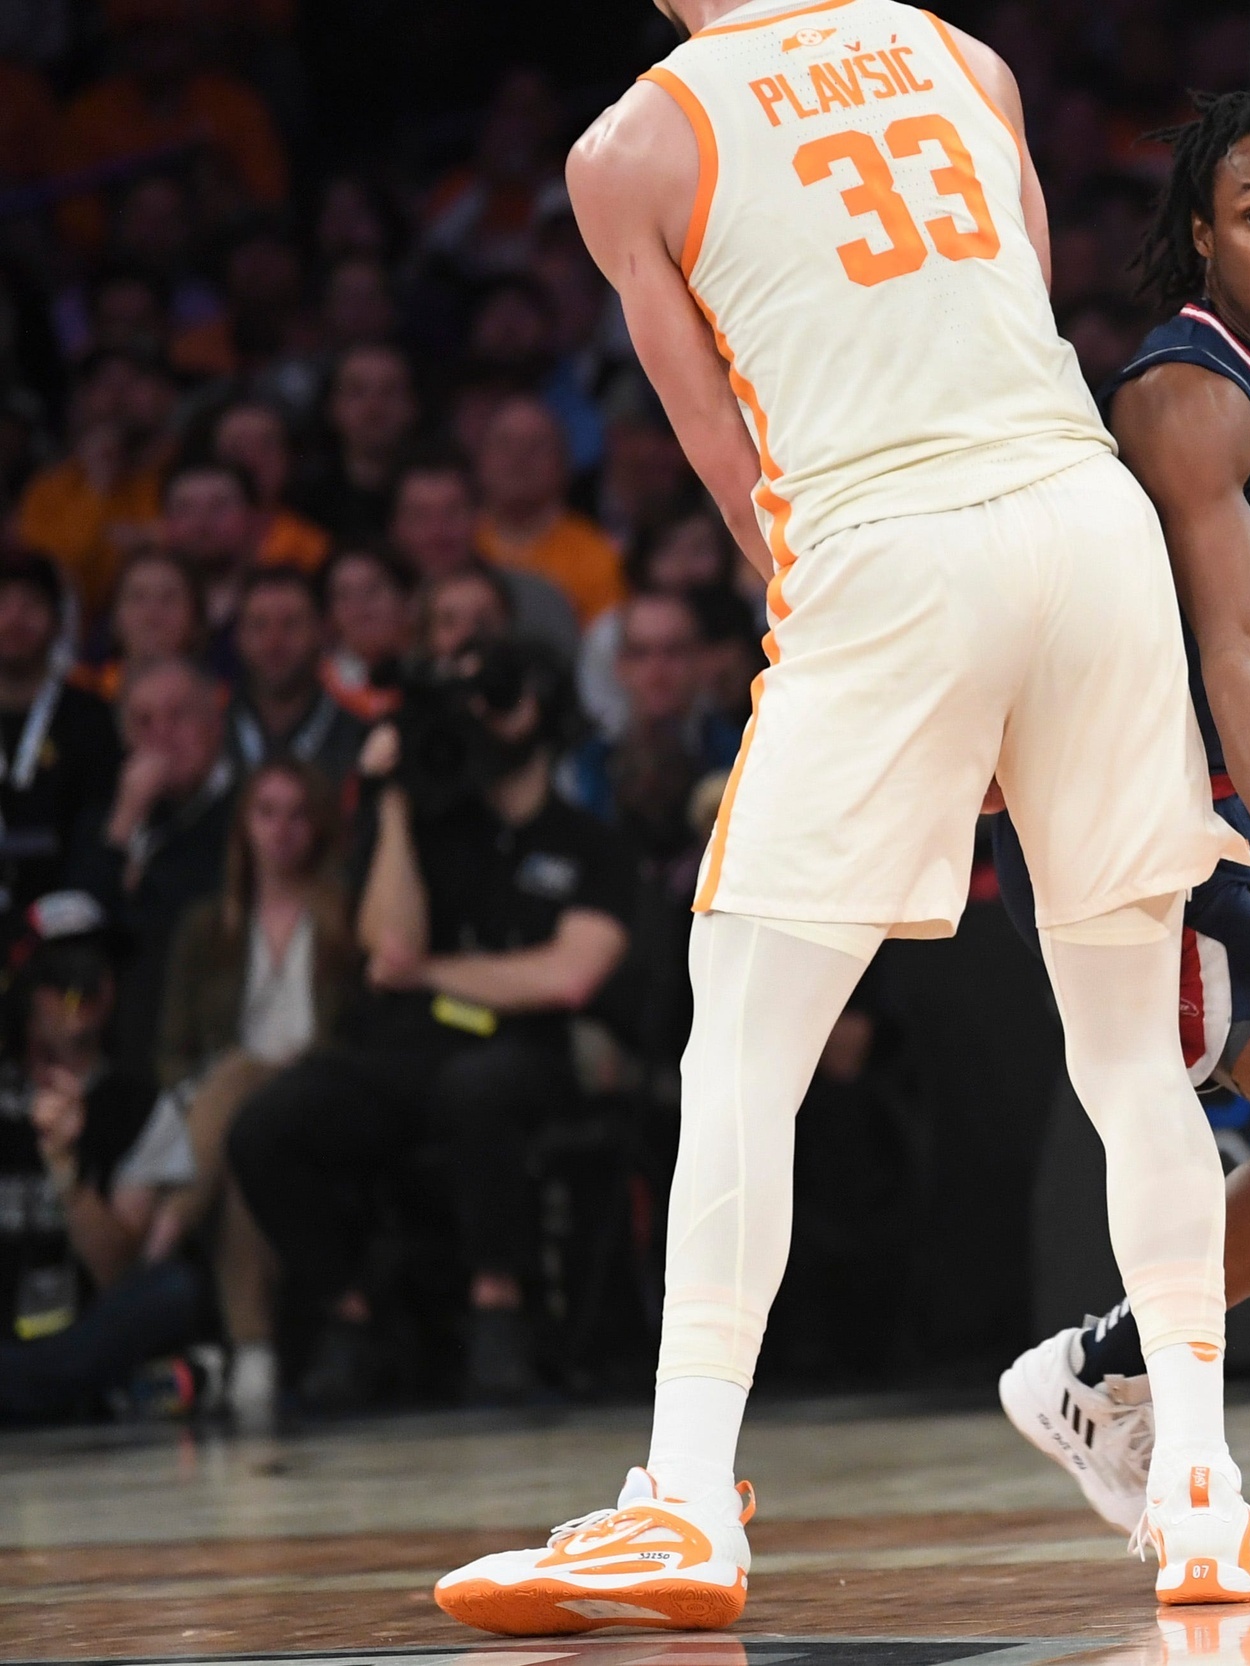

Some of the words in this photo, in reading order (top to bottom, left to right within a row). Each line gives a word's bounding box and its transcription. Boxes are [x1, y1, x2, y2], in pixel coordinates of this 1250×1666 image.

[749, 34, 933, 127] PLAVŠIĆ
[792, 114, 1001, 287] 33
[1192, 1565, 1209, 1579] 07
